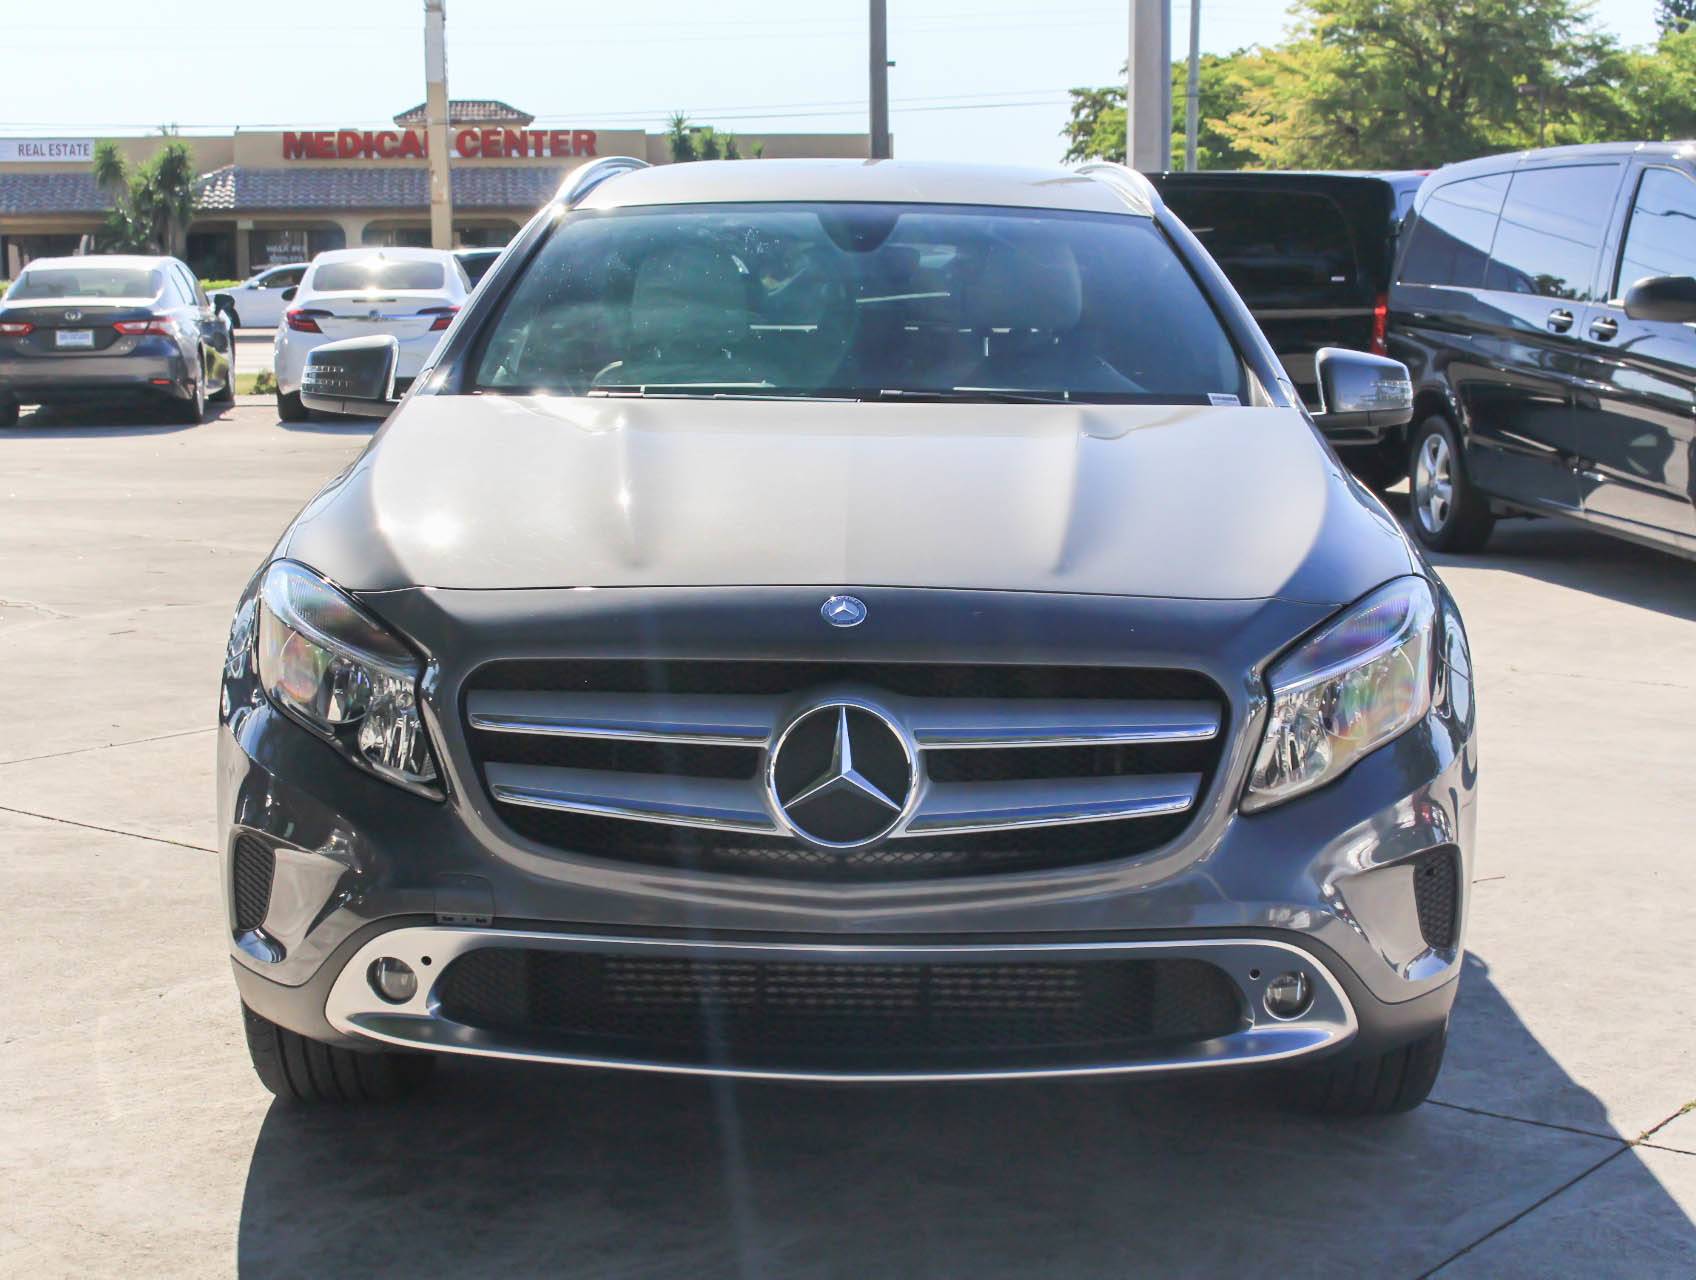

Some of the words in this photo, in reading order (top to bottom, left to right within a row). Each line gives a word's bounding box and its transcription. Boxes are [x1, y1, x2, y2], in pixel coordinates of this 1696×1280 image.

[18, 143, 46, 157] REAL
[48, 143, 90, 157] ESTATE
[455, 129, 597, 158] CENTER
